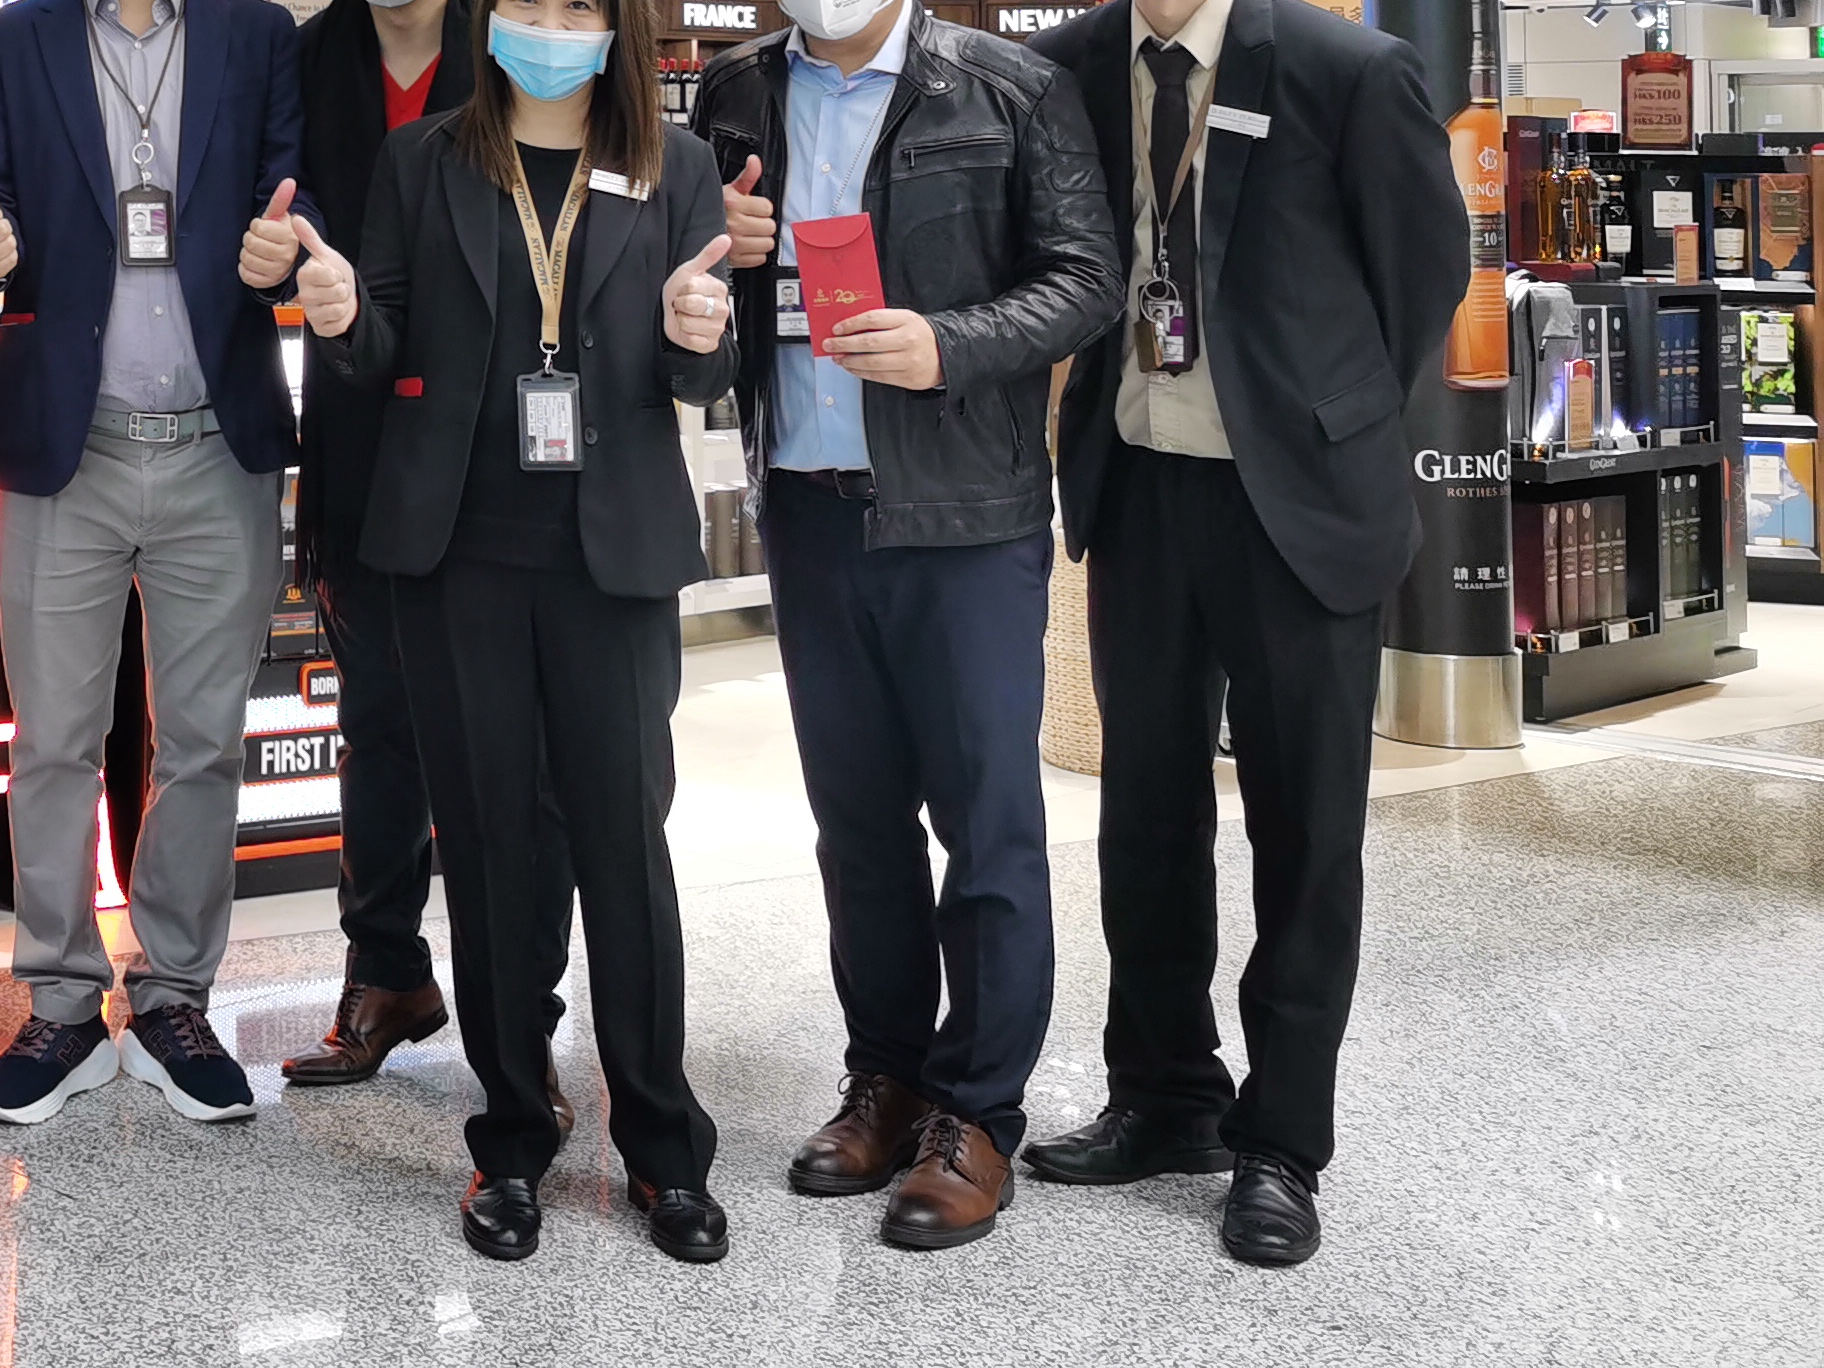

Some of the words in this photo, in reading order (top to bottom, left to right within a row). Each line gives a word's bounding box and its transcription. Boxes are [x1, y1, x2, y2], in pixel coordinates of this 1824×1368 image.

[683, 2, 757, 29] FRANCE
[998, 8, 1065, 32] NEW
[1483, 232, 1497, 246] 10
[1413, 449, 1508, 482] GLENG
[1446, 487, 1498, 498] ROTHES
[260, 735, 325, 776] FIRST
